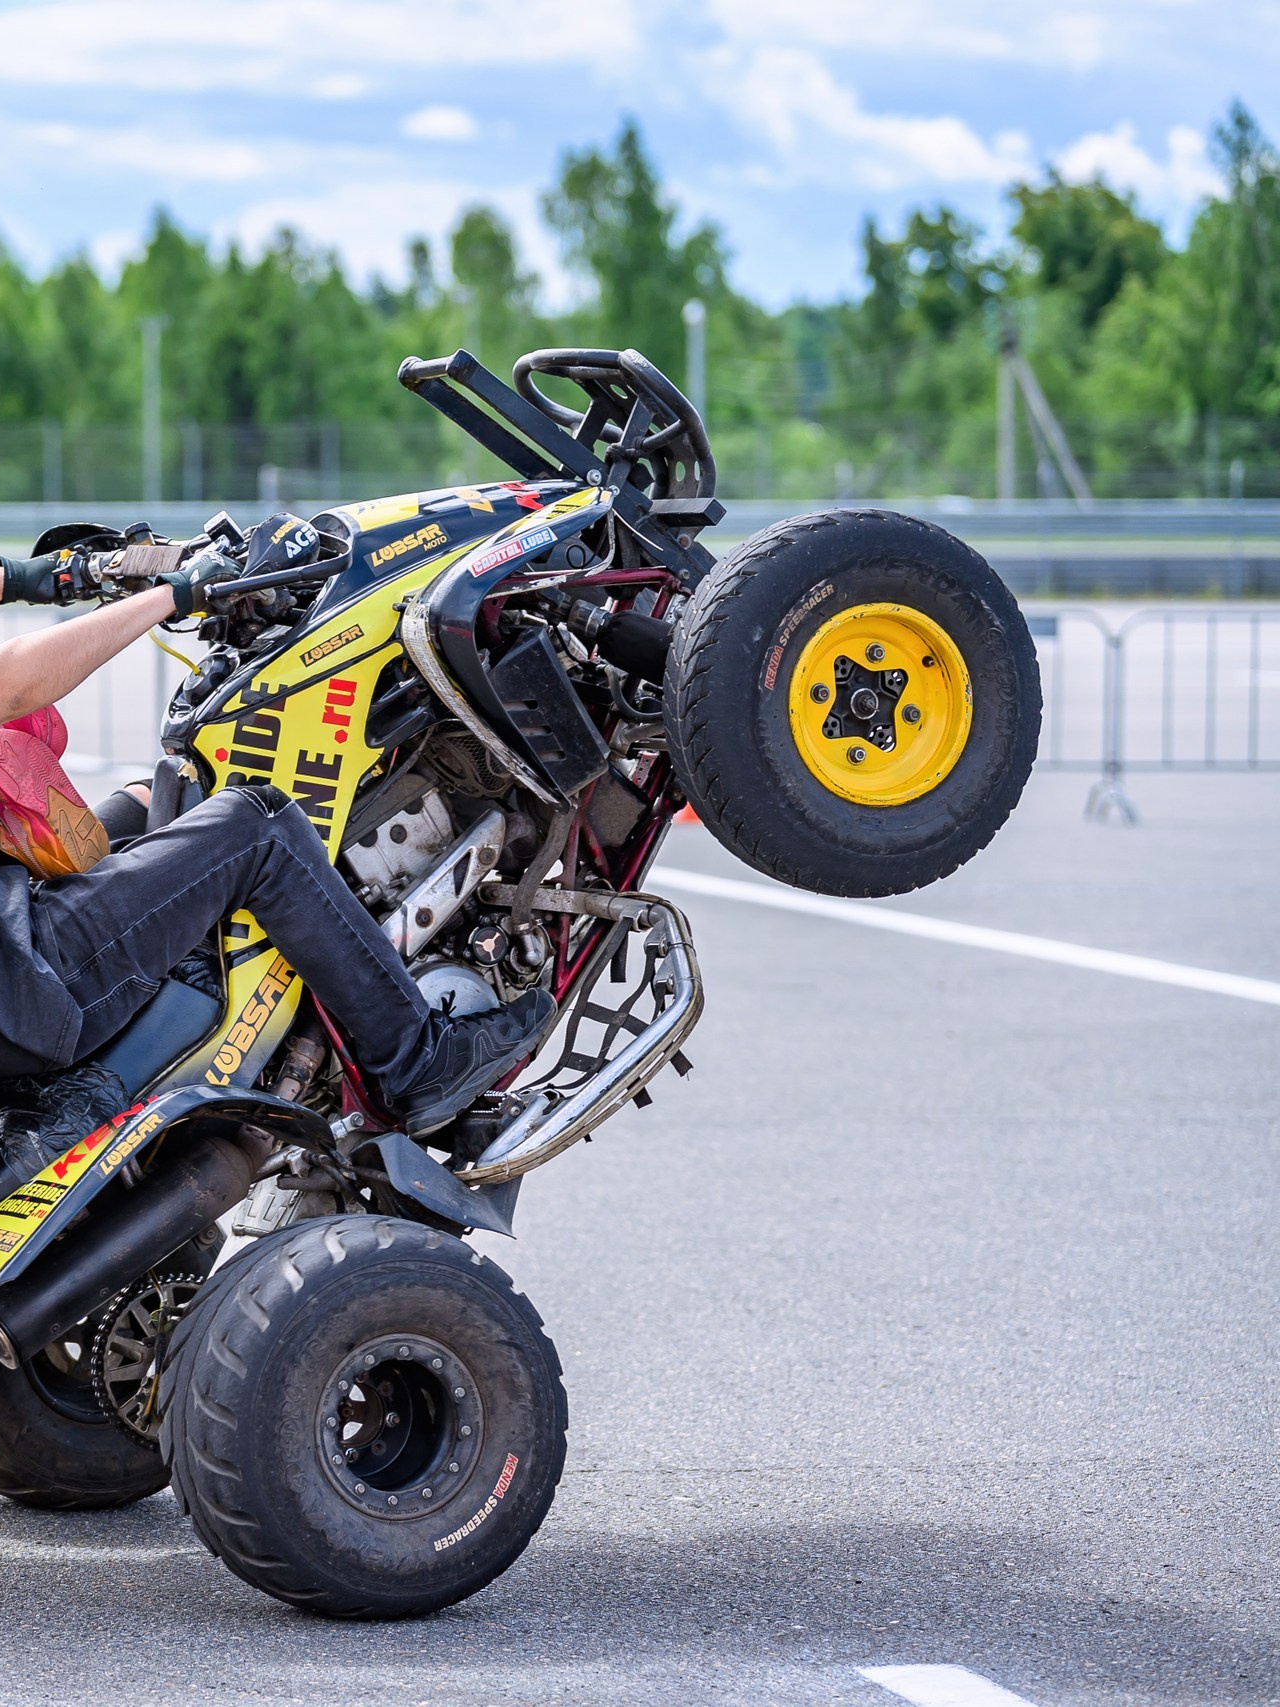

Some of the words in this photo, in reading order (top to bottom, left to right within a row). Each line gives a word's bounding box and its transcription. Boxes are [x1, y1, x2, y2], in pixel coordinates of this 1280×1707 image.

[284, 525, 319, 559] ACE
[423, 535, 448, 552] MOTO
[472, 543, 522, 573] CAPITAL
[521, 529, 553, 551] LUBE
[764, 644, 785, 691] KENDA
[779, 583, 835, 647] SPEEDRACER
[492, 1452, 519, 1499] KENDA
[433, 1495, 498, 1552] SPEEDRACER
